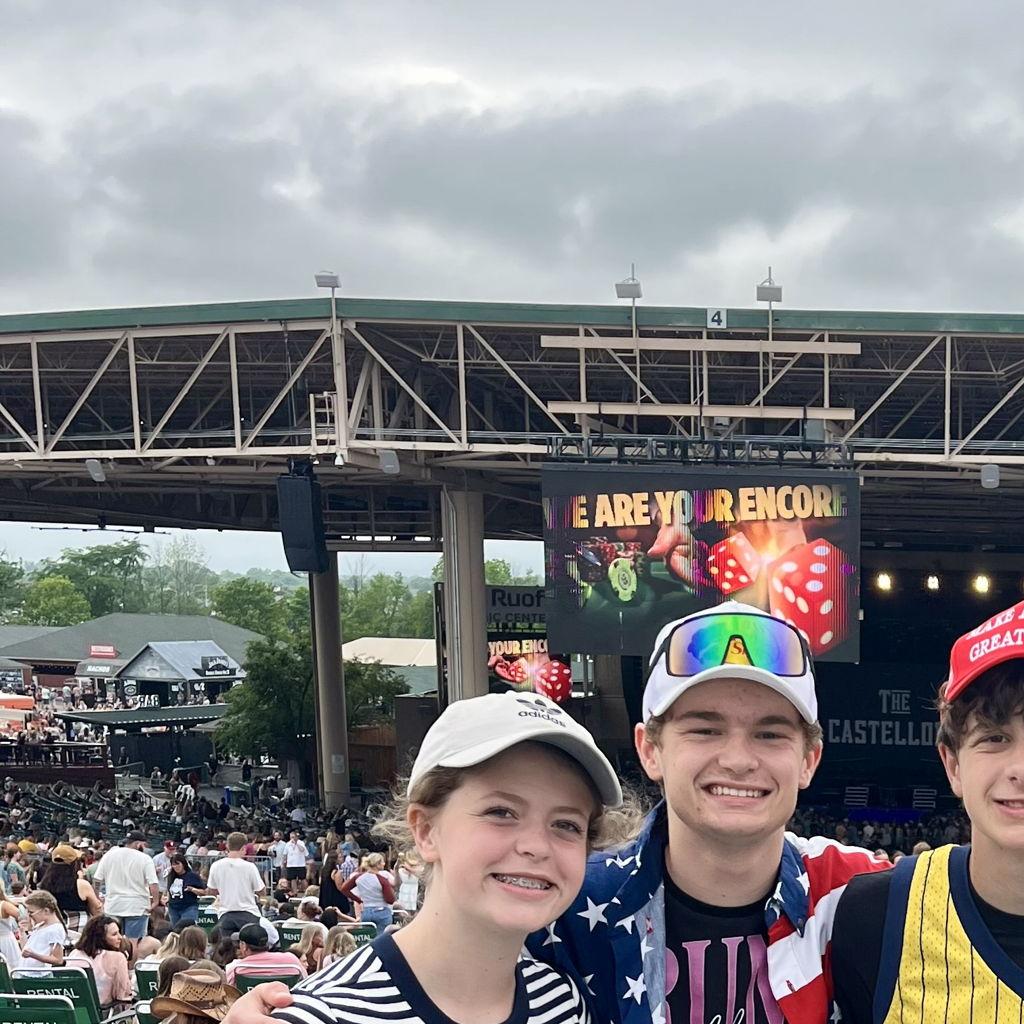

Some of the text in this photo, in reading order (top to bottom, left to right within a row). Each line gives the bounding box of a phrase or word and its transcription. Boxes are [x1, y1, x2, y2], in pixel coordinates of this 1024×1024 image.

[711, 310, 723, 326] 4
[594, 492, 651, 527] ARE
[654, 488, 735, 525] YOUR
[488, 640, 521, 656] YOUR
[879, 689, 911, 714] THE
[518, 710, 567, 728] adidas
[828, 719, 940, 746] CASTELLO
